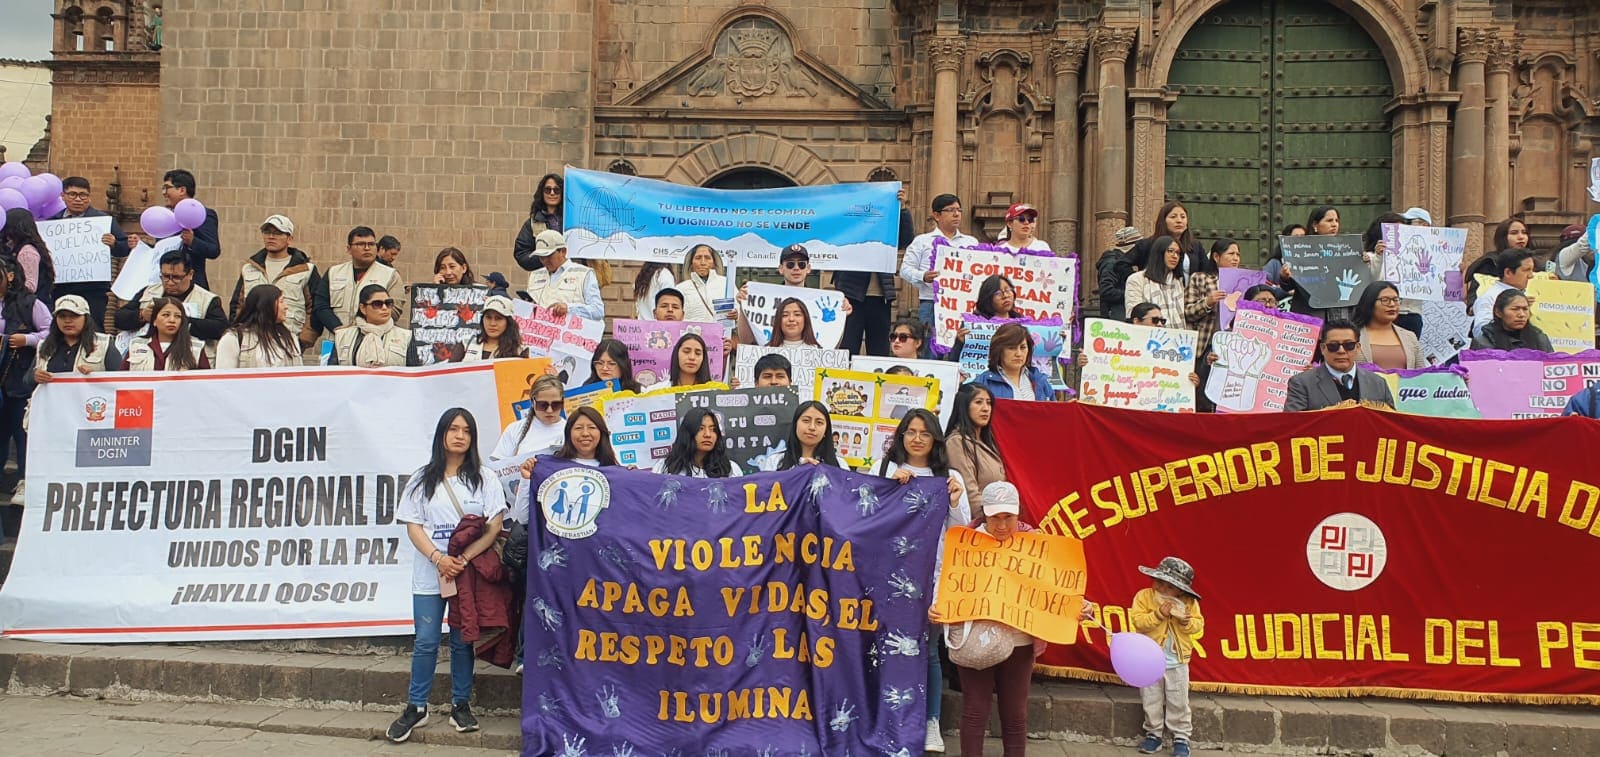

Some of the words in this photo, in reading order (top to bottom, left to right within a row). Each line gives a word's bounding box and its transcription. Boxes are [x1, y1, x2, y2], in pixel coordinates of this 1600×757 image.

[658, 202, 672, 210] TU
[676, 205, 728, 214] LIBERTAD
[751, 208, 765, 216] SE
[768, 208, 815, 216] COMPRA
[45, 220, 93, 237] GOLPES
[660, 216, 675, 225] TU
[678, 217, 733, 227] DIGNIDAD
[736, 220, 753, 228] NO
[756, 221, 770, 229] SE
[774, 221, 811, 230] VENDE
[54, 250, 110, 267] ALABRAS
[943, 257, 963, 273] NI
[970, 262, 1034, 283] GOLPES
[939, 278, 972, 293] QUE
[747, 294, 766, 309] NO
[940, 296, 958, 311] NI
[945, 318, 960, 330] QU
[969, 333, 992, 341] nunc
[964, 341, 989, 351] soluc
[961, 351, 988, 360] perpe
[962, 362, 986, 370] ciclo
[1545, 365, 1577, 377] SOY
[1542, 380, 1565, 391] NO
[690, 395, 710, 408] TU
[752, 393, 789, 406] VALE,
[1398, 388, 1428, 402] que
[1433, 386, 1471, 400] duelan,
[1530, 396, 1567, 407] TRAB
[119, 405, 143, 417] PERÚ
[728, 416, 747, 428] TU
[90, 436, 140, 447] MININTER
[252, 426, 327, 464] DGIN
[616, 434, 640, 442] QUITE
[725, 435, 772, 449] ORTA
[97, 448, 128, 459] DGIN
[1090, 441, 1281, 528] SUPERIOR
[1290, 434, 1346, 483] DE
[1355, 437, 1549, 519] JUSTICIA
[42, 478, 221, 533] PREFECTURA
[228, 475, 369, 529] REGIONAL
[742, 481, 789, 514] LA
[168, 538, 258, 569] UNIDOS
[264, 538, 313, 567] POR
[318, 538, 351, 566] LA
[354, 537, 400, 565] PAZ
[648, 531, 857, 572] VIOLENCIA
[952, 547, 1000, 568] MUJER
[1004, 556, 1024, 575] DE
[1052, 567, 1086, 591] VIDA
[171, 583, 271, 606] ¡HAYLLI
[275, 581, 379, 604] QOSQO!
[576, 578, 696, 618] APAGA
[947, 572, 976, 594] SOY
[983, 576, 1007, 597] LA
[1016, 583, 1073, 616] MUJER
[574, 629, 735, 668] RESPETO
[772, 627, 836, 669] LAS
[1220, 612, 1409, 663] JUDICIAL
[1424, 618, 1521, 669] DEL
[657, 686, 815, 724] ILUMINA
